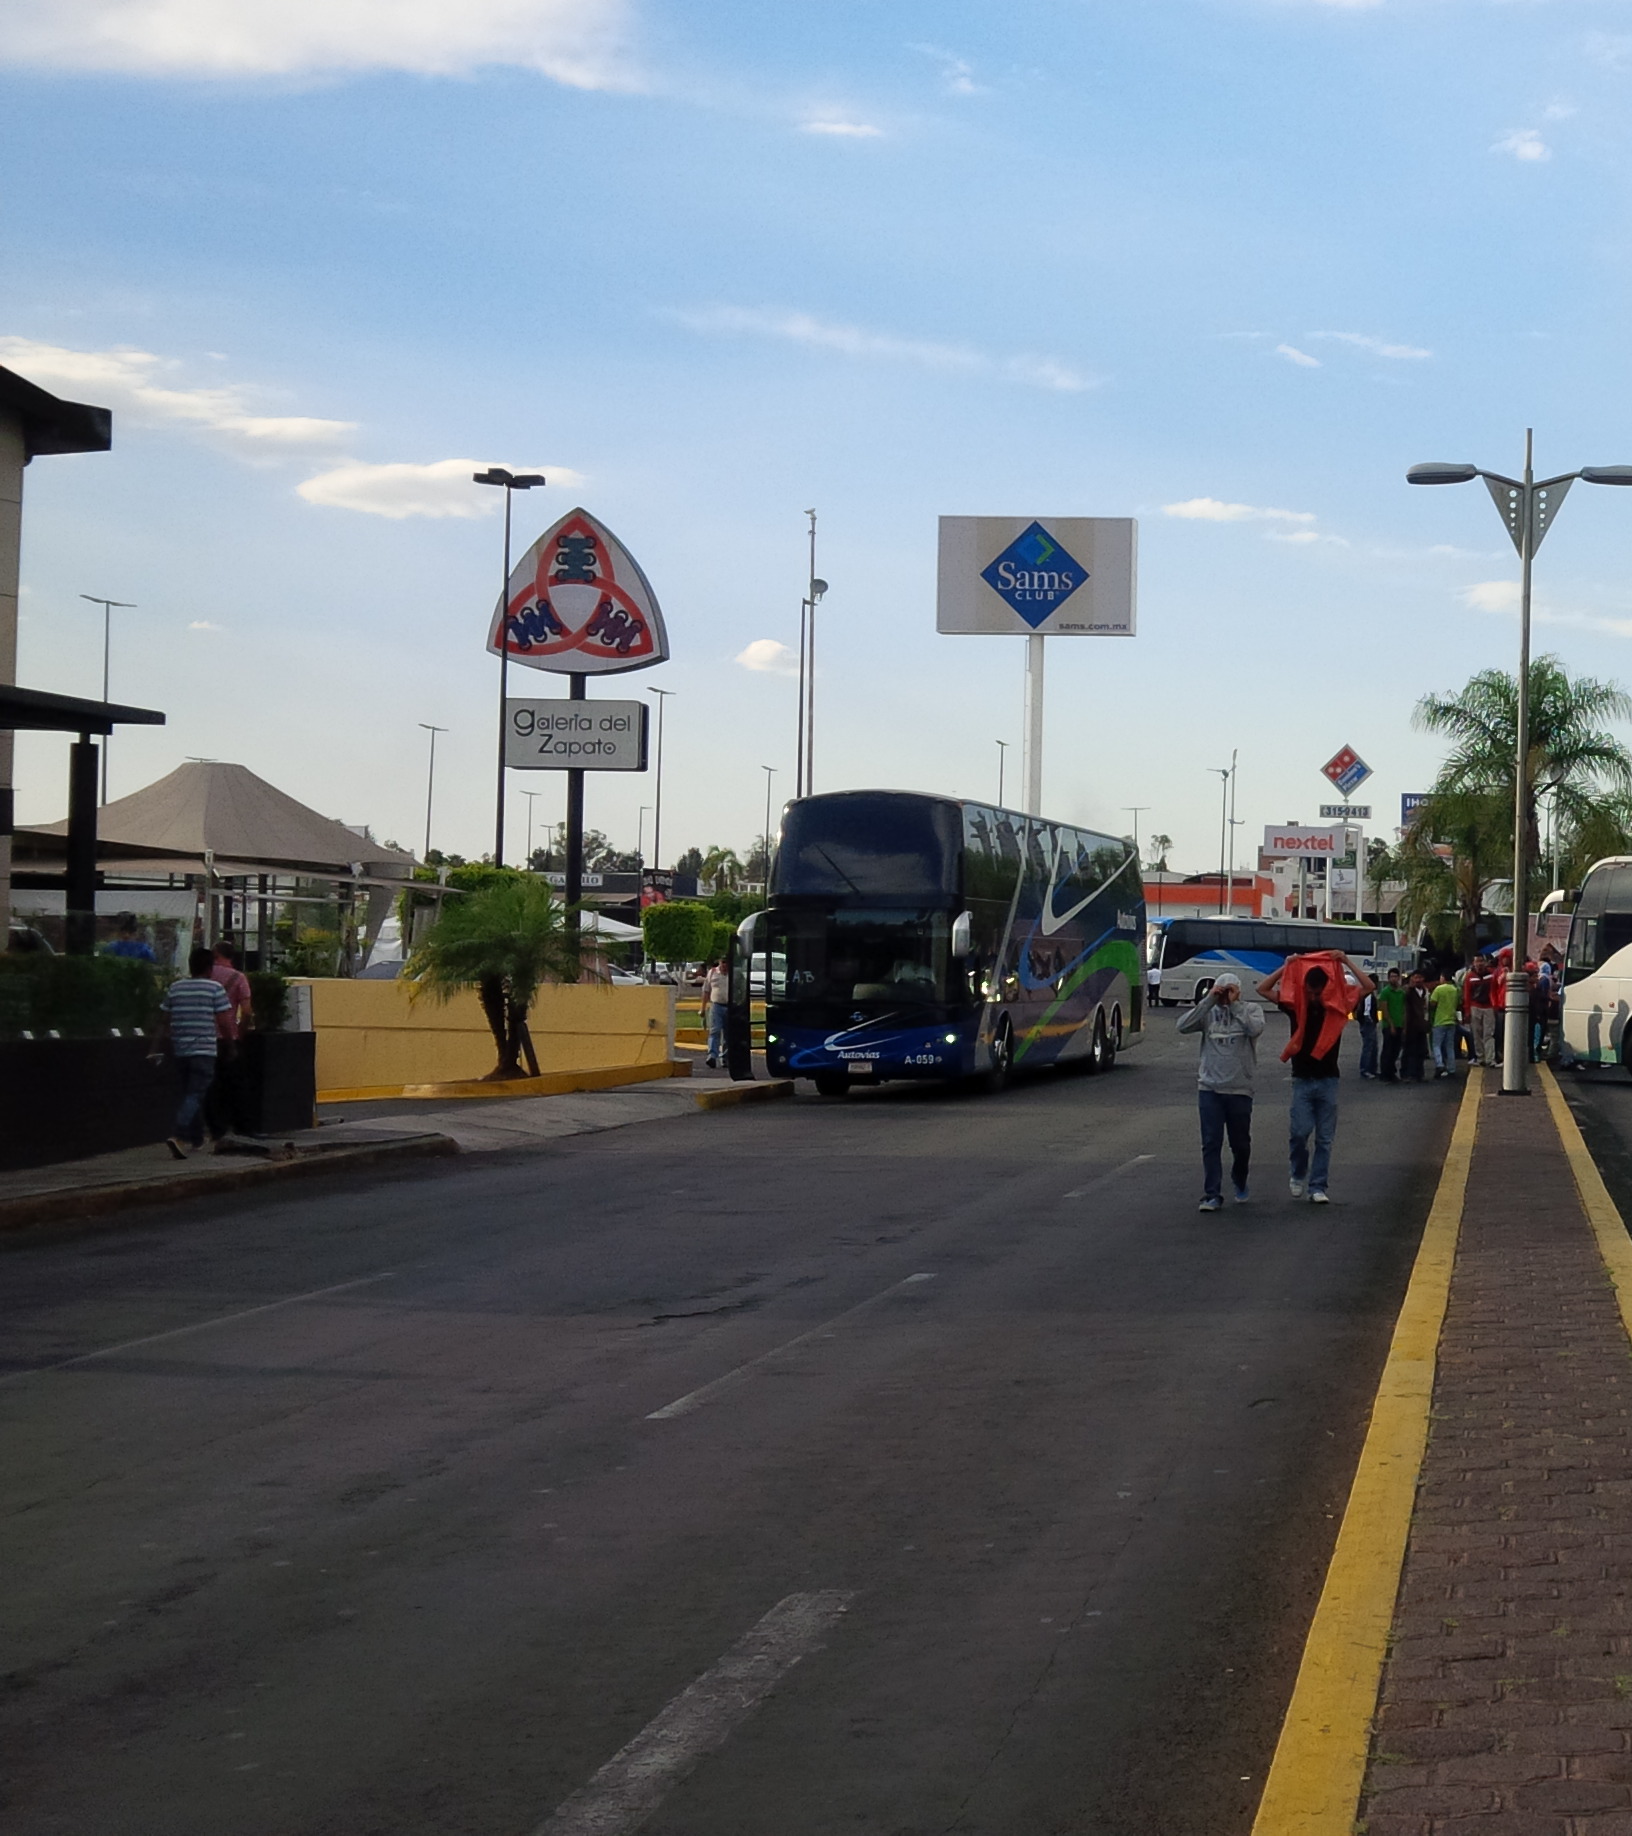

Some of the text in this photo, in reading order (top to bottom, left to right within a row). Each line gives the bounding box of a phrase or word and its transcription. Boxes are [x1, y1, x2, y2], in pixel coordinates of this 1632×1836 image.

[998, 561, 1074, 591] Sams
[1015, 591, 1055, 601] CLUB
[1058, 623, 1128, 631] sams.com.mx
[599, 714, 632, 732] del
[538, 733, 617, 758] Zapato
[1273, 834, 1335, 851] nextel
[904, 1054, 935, 1065] A-059
